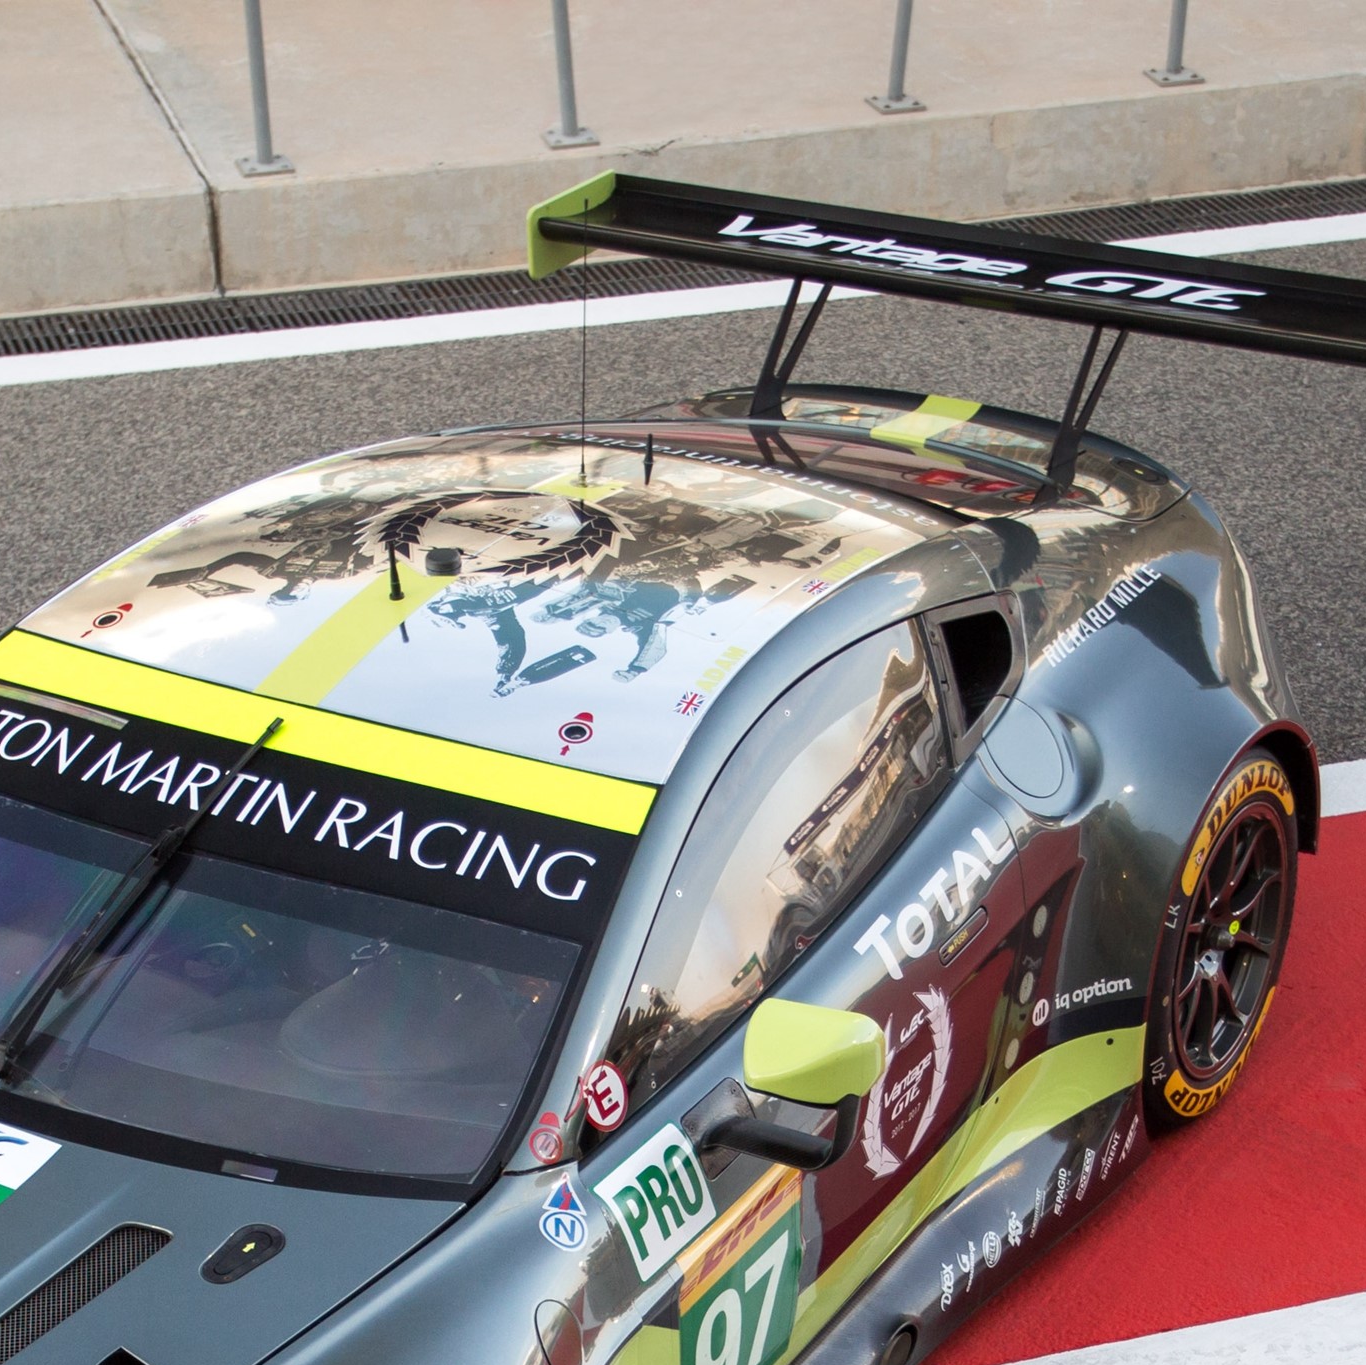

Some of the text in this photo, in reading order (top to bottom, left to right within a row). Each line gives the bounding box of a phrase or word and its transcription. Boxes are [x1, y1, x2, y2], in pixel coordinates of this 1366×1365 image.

[717, 214, 1267, 311] Vantage GTE
[438, 517, 551, 546] Vantage
[1042, 564, 1162, 667] RICHARD MILLE
[695, 645, 748, 694] ADAM
[82, 741, 317, 834] MARTIN
[313, 797, 597, 901] RACING
[1207, 764, 1291, 841] DUNLOP
[853, 827, 1013, 981] TOTAL
[1055, 977, 1133, 1010] iq option
[899, 1008, 926, 1044] WEC
[884, 1051, 933, 1109] Vantage
[891, 1078, 922, 1121] GTE
[1101, 1132, 1120, 1181] SPIRENT
[611, 1143, 704, 1262] PRO
[1056, 1167, 1067, 1204] PAGID
[695, 1183, 787, 1285] DHL
[986, 1231, 999, 1266] HELLA
